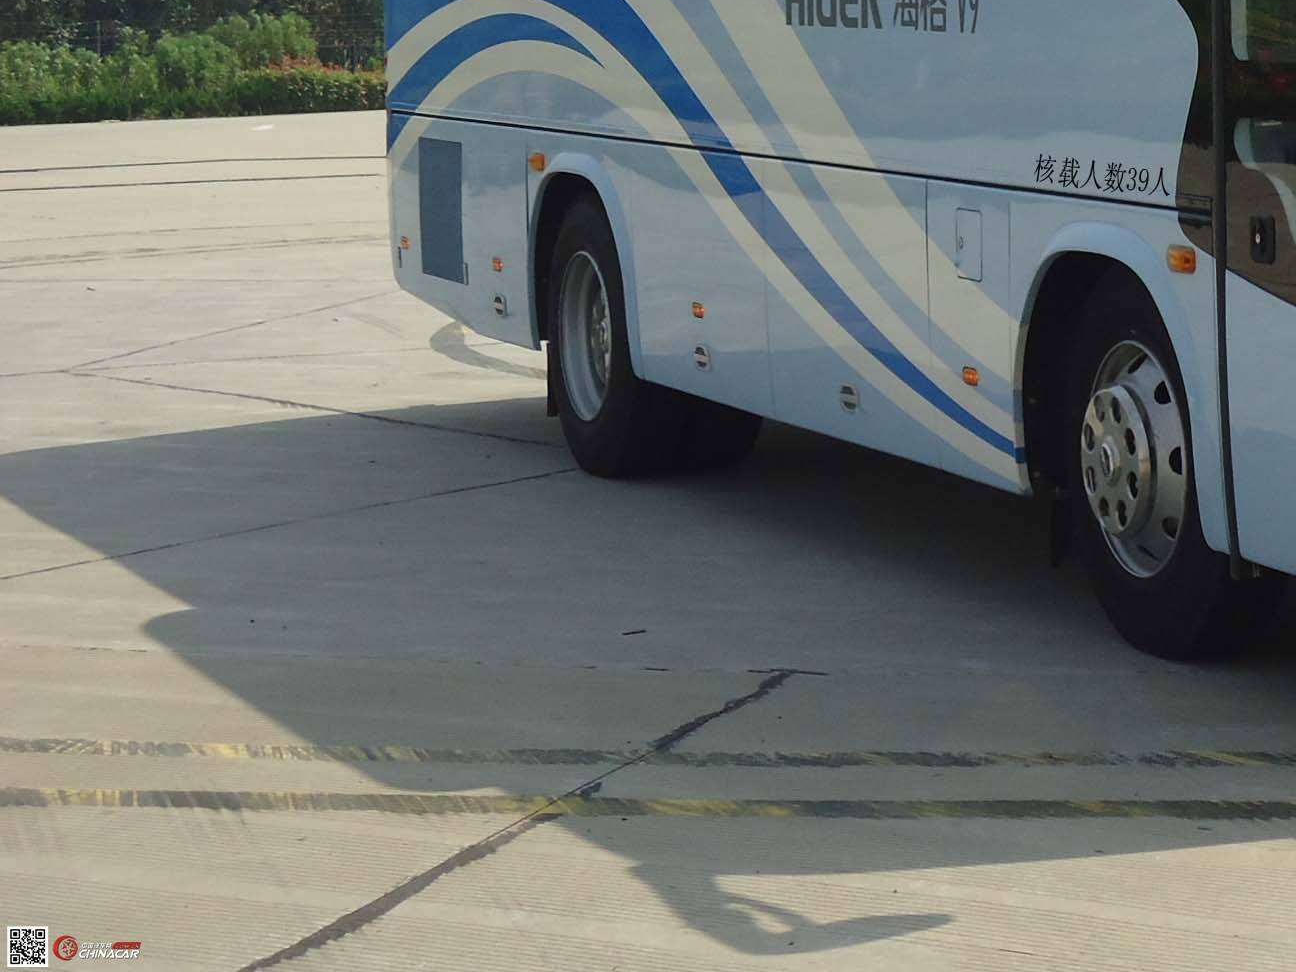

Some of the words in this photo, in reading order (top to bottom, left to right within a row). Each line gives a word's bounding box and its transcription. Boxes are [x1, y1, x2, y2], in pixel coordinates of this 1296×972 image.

[1034, 153, 1170, 196] 核载人数39人
